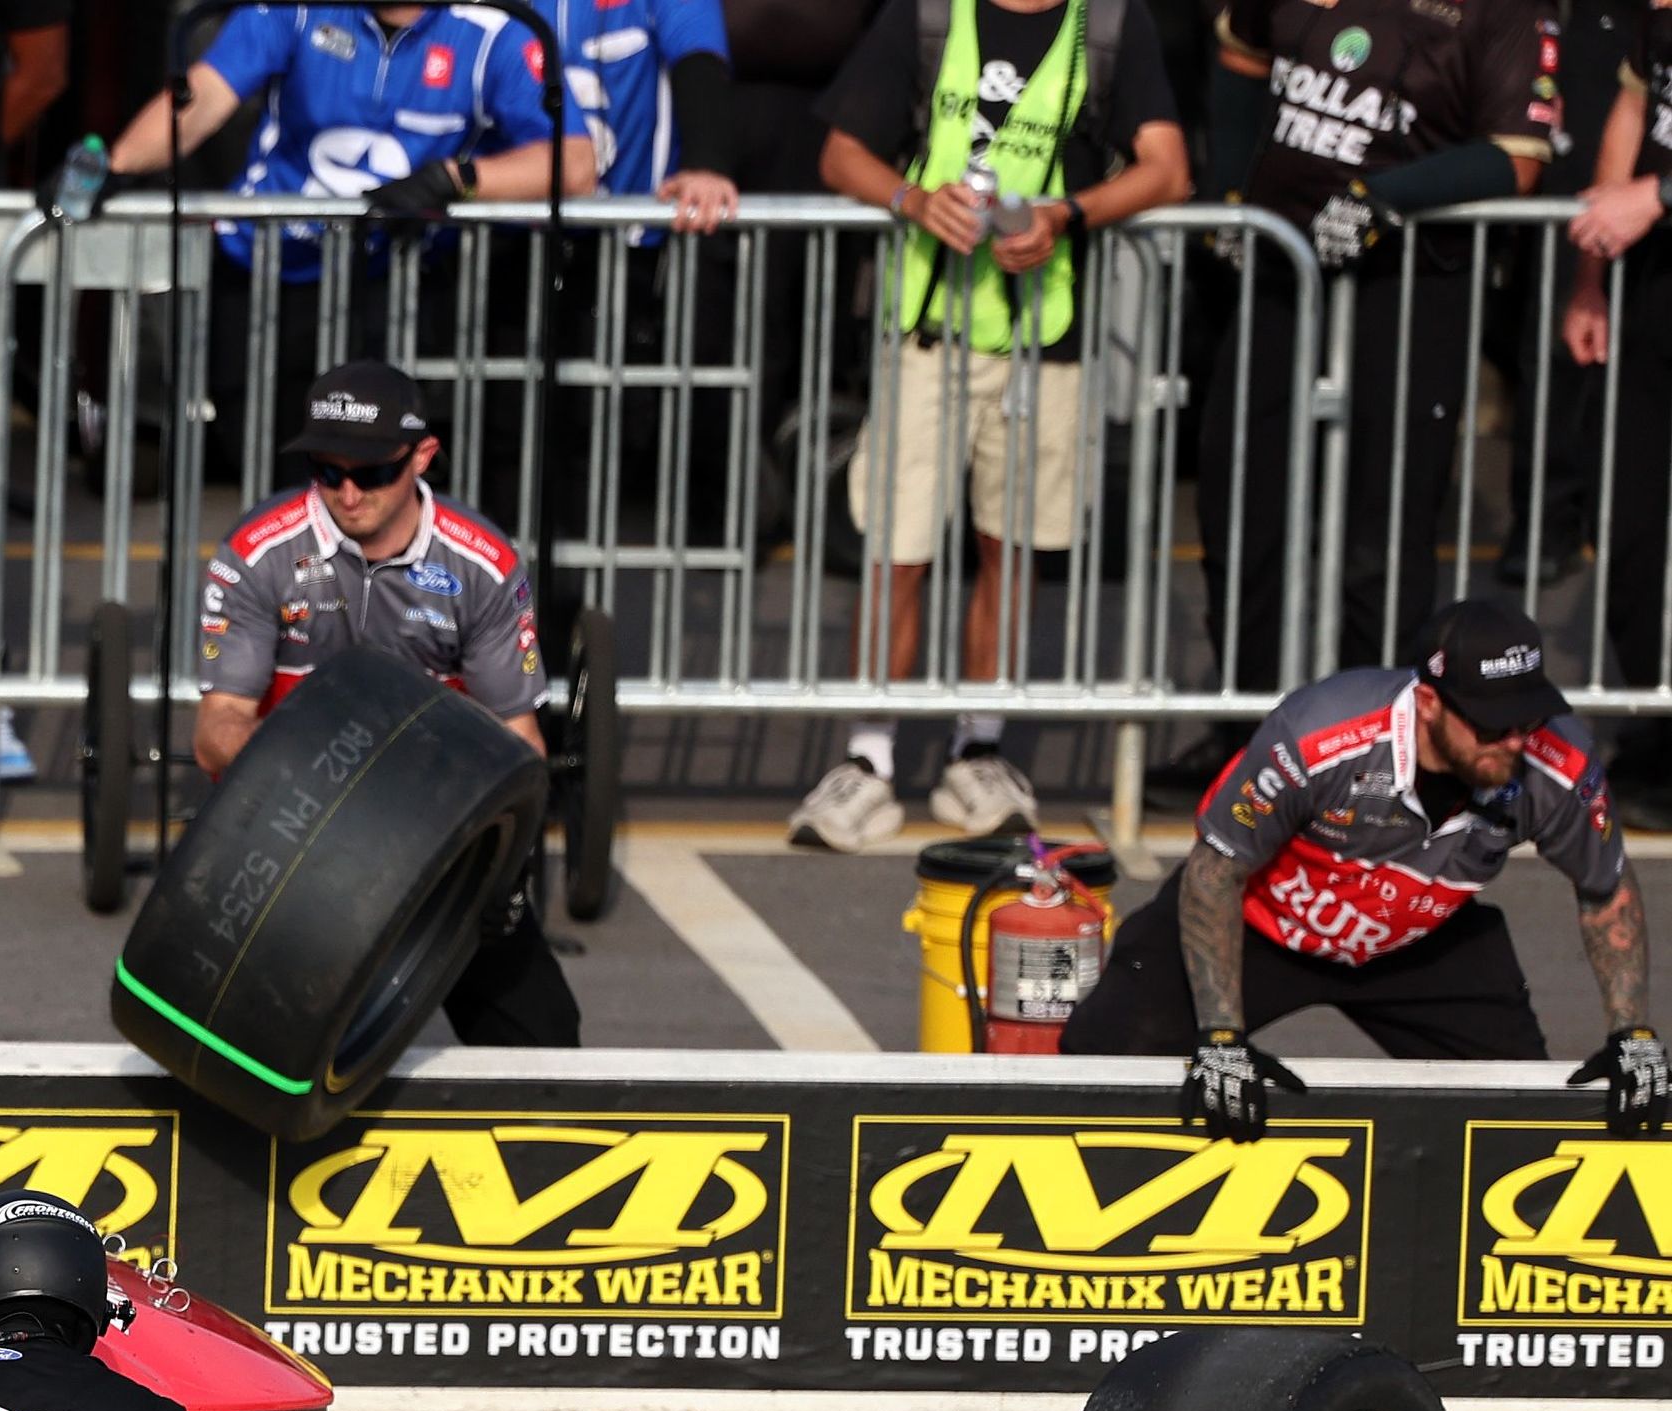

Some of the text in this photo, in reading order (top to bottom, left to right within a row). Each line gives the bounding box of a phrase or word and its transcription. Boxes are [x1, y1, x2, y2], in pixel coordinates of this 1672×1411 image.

[1273, 104, 1374, 166] TREE
[268, 785, 323, 844] PN
[207, 849, 281, 945] 5254
[285, 1243, 763, 1305] MECHANIX WEAR
[866, 1249, 1345, 1312] MECHANIX WEAR
[1481, 1254, 1672, 1314] MECHA
[263, 1321, 781, 1361] TRUSTED PROTECTION
[845, 1326, 1052, 1362] TRUSTED
[1457, 1333, 1666, 1369] TRUSTED
